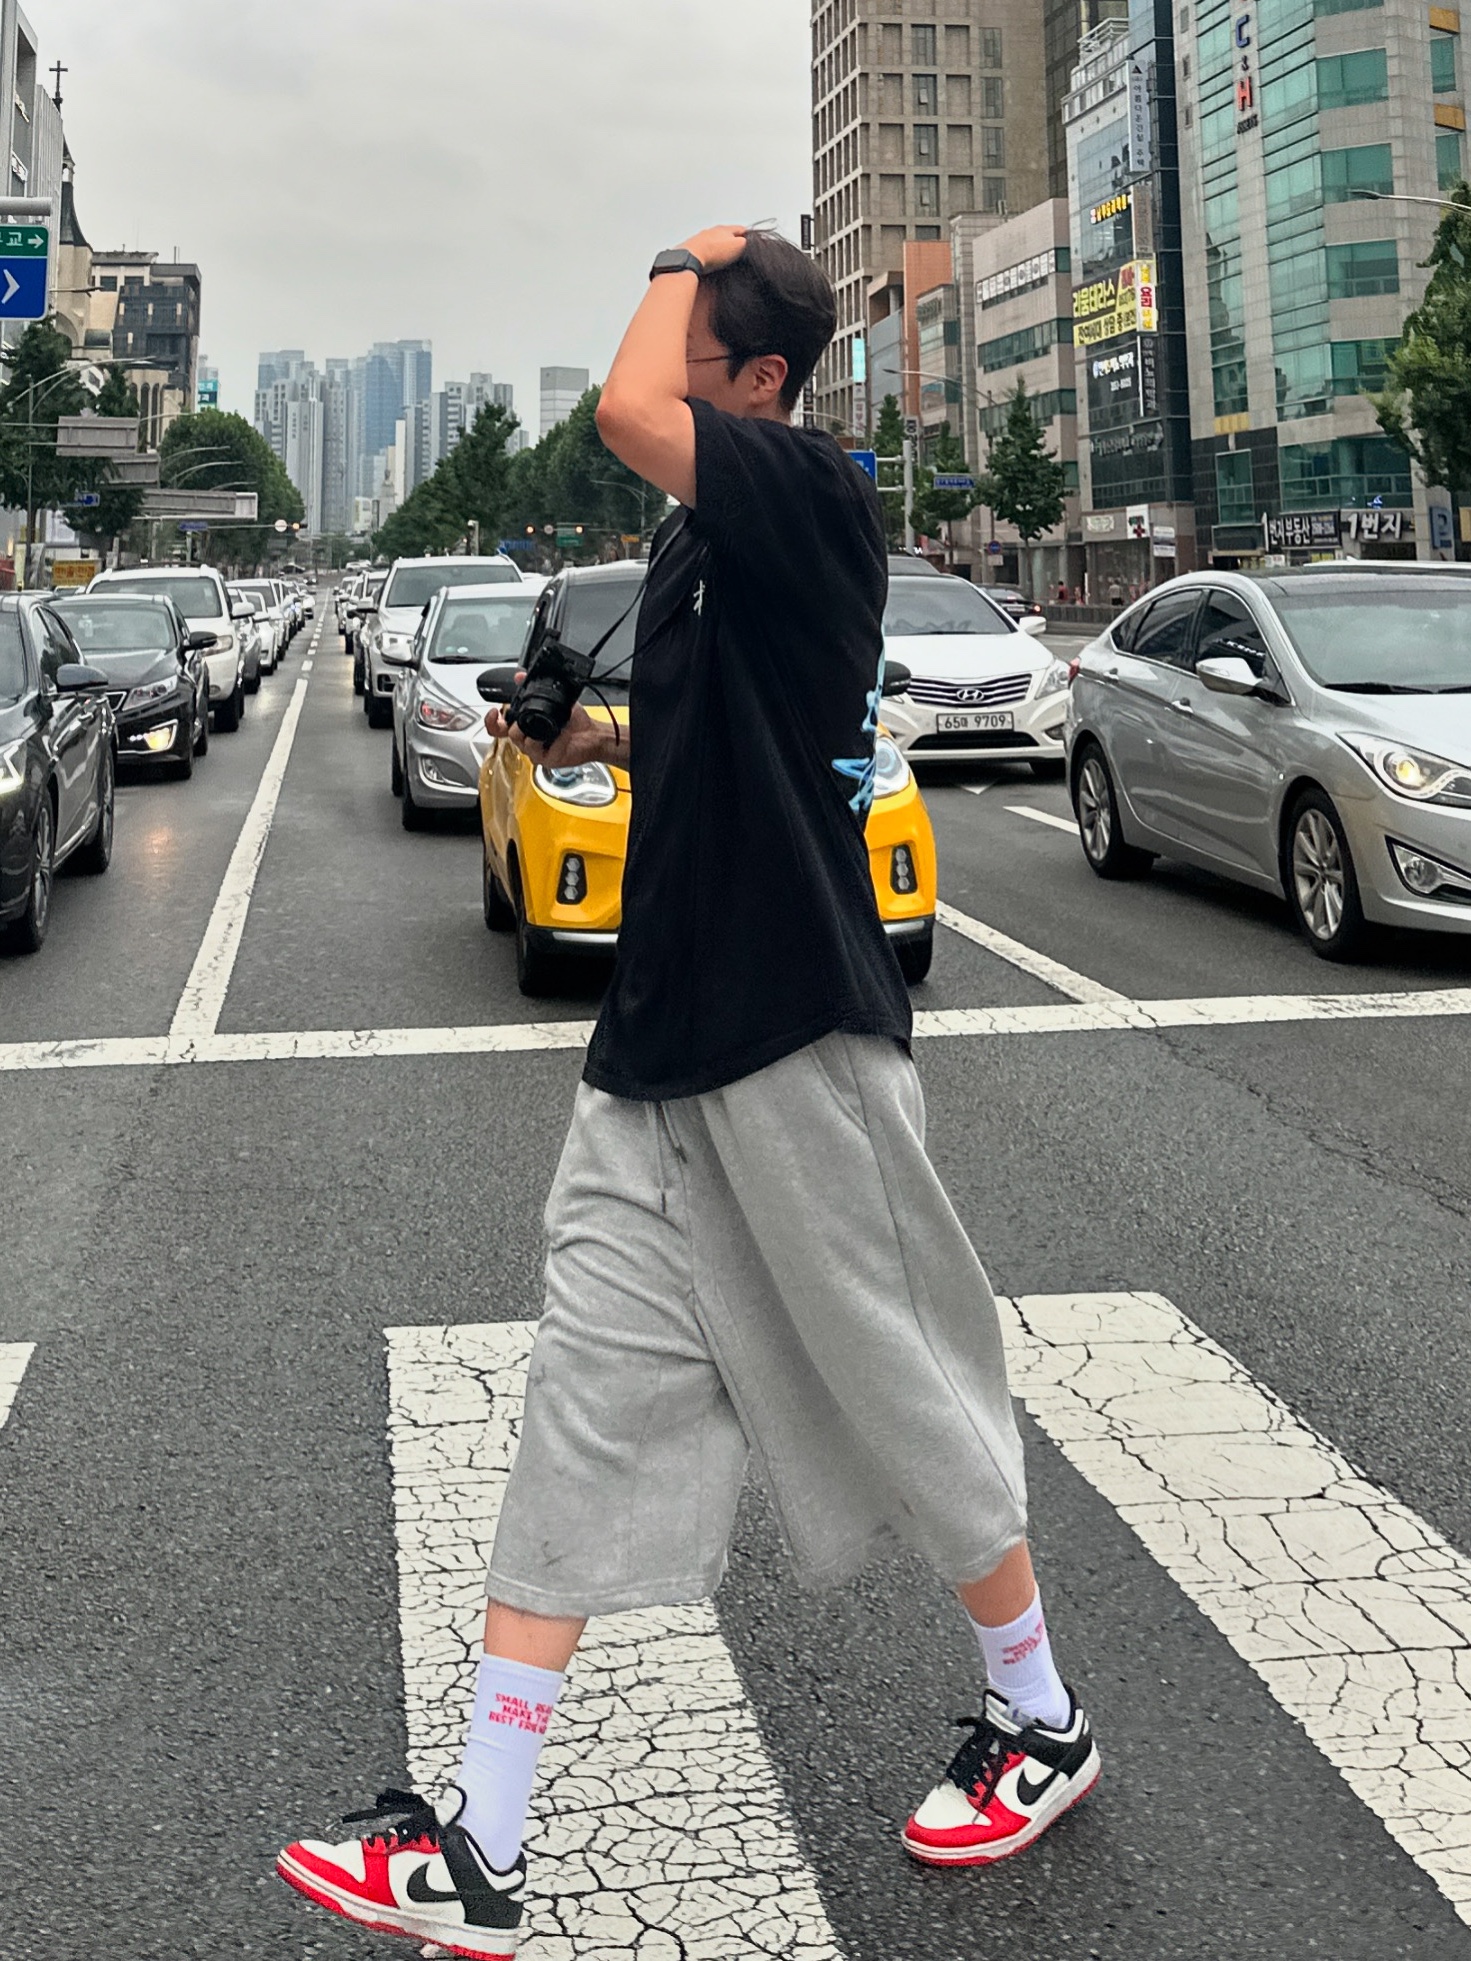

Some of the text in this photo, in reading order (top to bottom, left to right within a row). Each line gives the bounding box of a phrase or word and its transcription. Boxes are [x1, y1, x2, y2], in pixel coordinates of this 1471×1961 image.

[1347, 512, 1402, 540] 1번지
[974, 714, 1006, 728] 9709
[496, 1693, 529, 1710] SMALL
